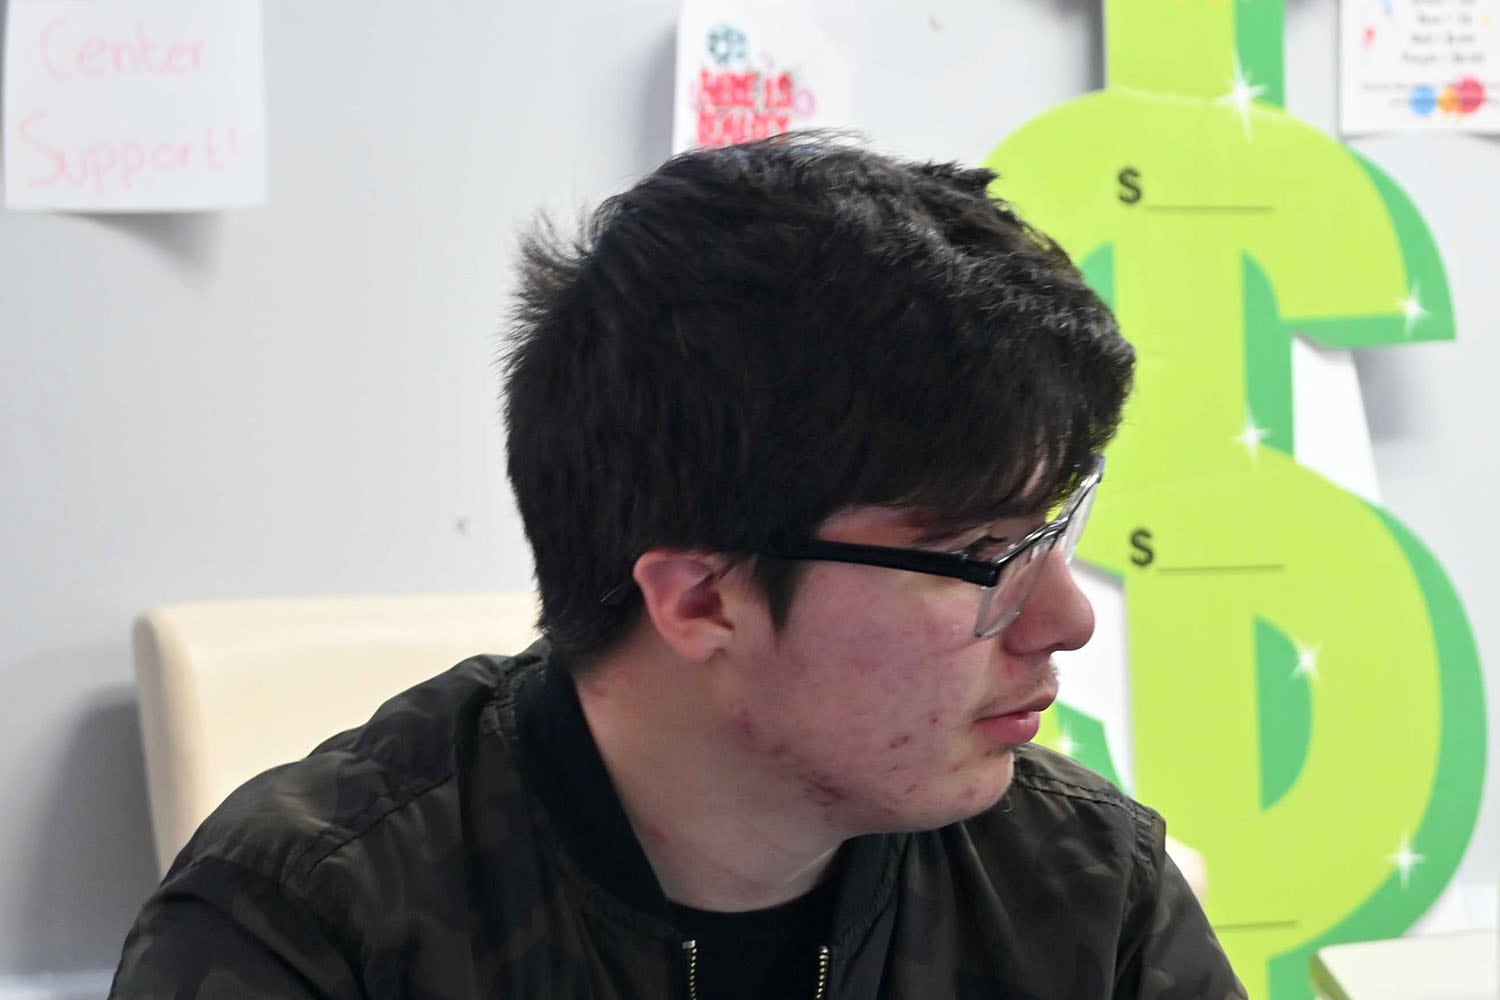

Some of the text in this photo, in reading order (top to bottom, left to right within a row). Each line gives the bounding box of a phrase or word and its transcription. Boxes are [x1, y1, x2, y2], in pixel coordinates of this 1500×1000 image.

[39, 17, 207, 83] Center
[1116, 165, 1144, 205] $
[1129, 527, 1156, 568] $
